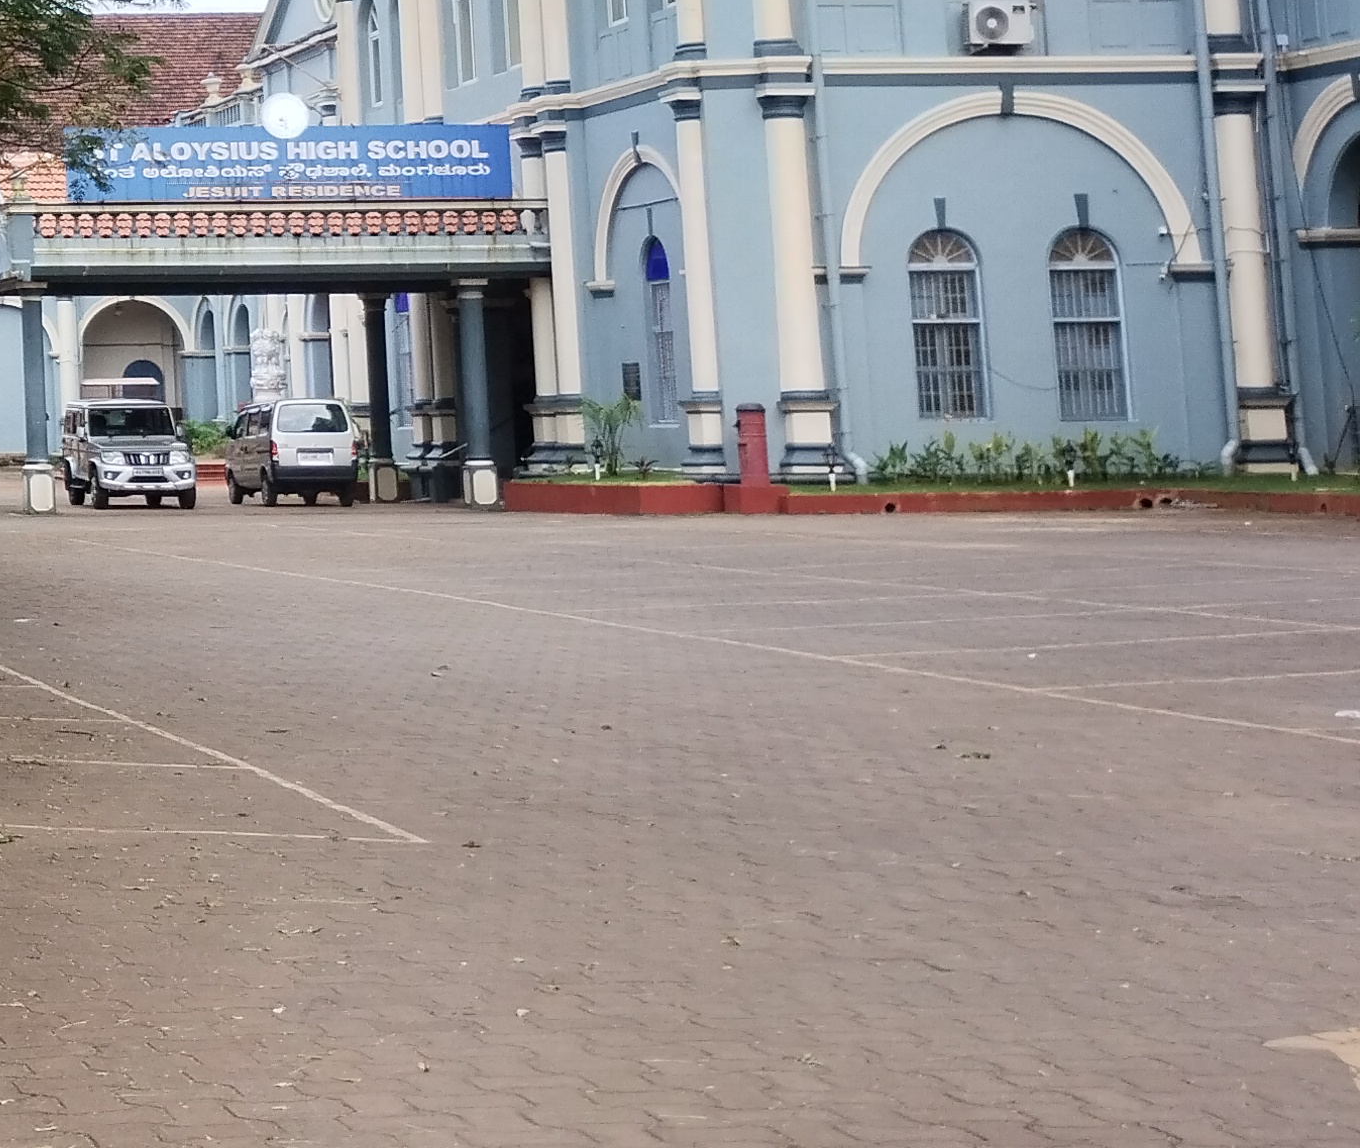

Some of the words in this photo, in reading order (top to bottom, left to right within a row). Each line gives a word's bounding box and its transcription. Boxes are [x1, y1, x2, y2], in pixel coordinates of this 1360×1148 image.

[131, 141, 279, 162] ALOYSIUS
[286, 141, 359, 160] HIGH
[366, 139, 490, 160] SCHOOL
[183, 185, 265, 199] JESUIT
[271, 185, 402, 198] RESIDENCE
